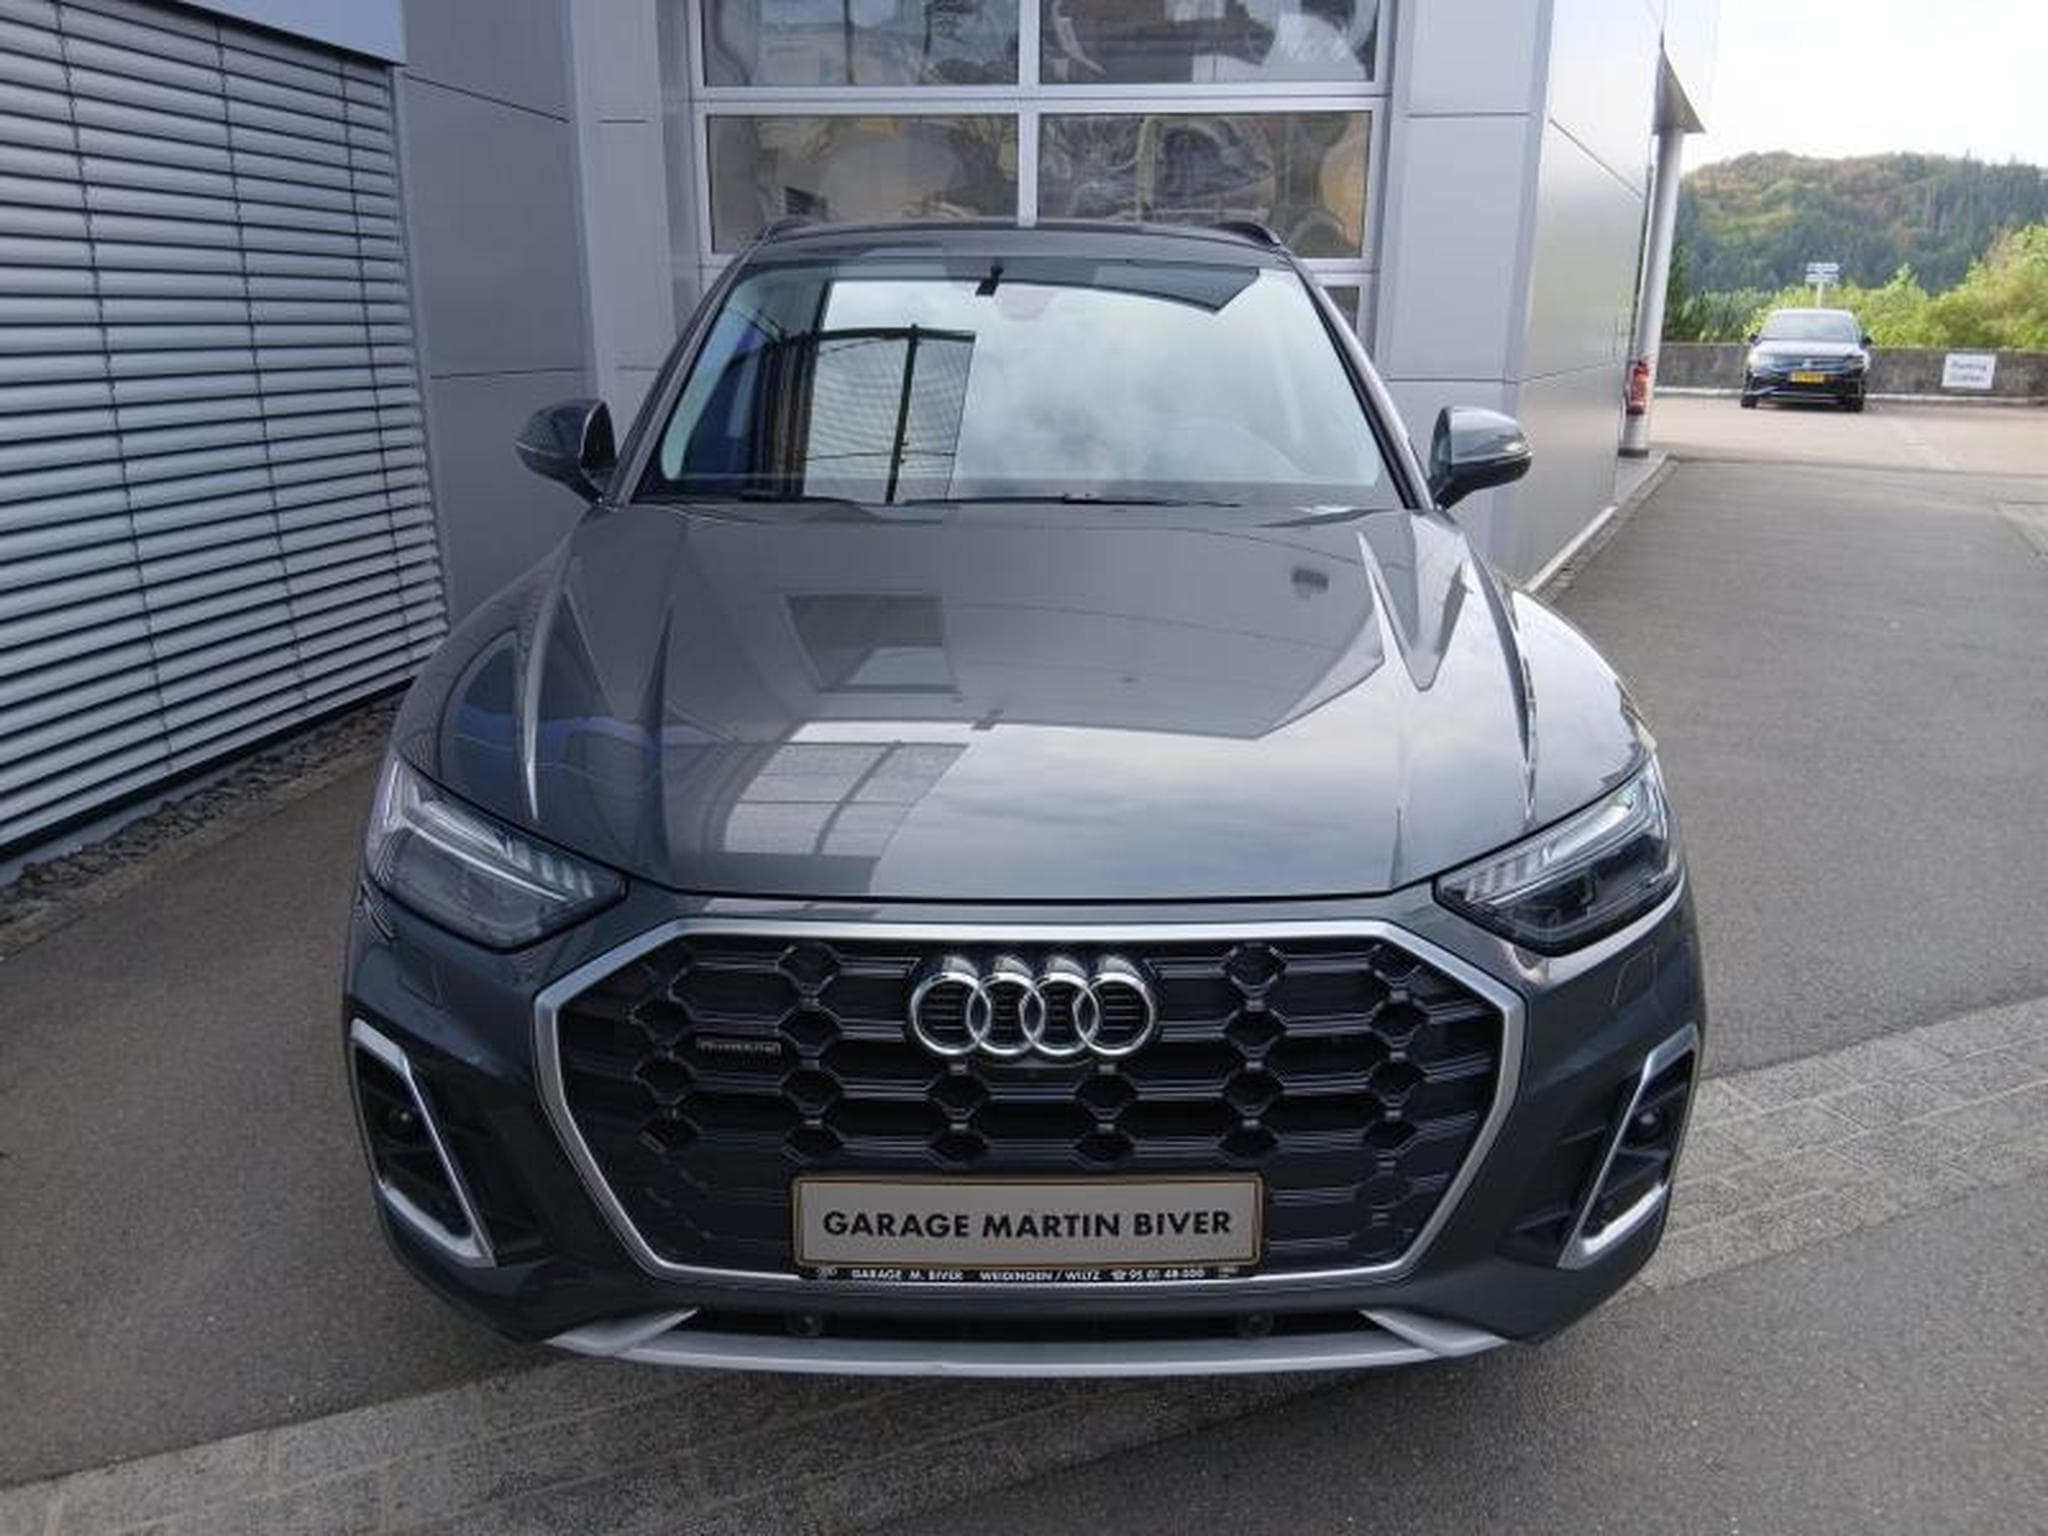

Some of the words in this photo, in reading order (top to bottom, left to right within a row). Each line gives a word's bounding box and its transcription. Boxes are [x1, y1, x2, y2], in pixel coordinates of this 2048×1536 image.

[823, 1211, 969, 1237] GARAGE
[982, 1213, 1120, 1237] MARTIN
[1134, 1211, 1230, 1235] BIVER
[851, 1269, 902, 1280] GARAGE
[929, 1269, 963, 1280] BIVER
